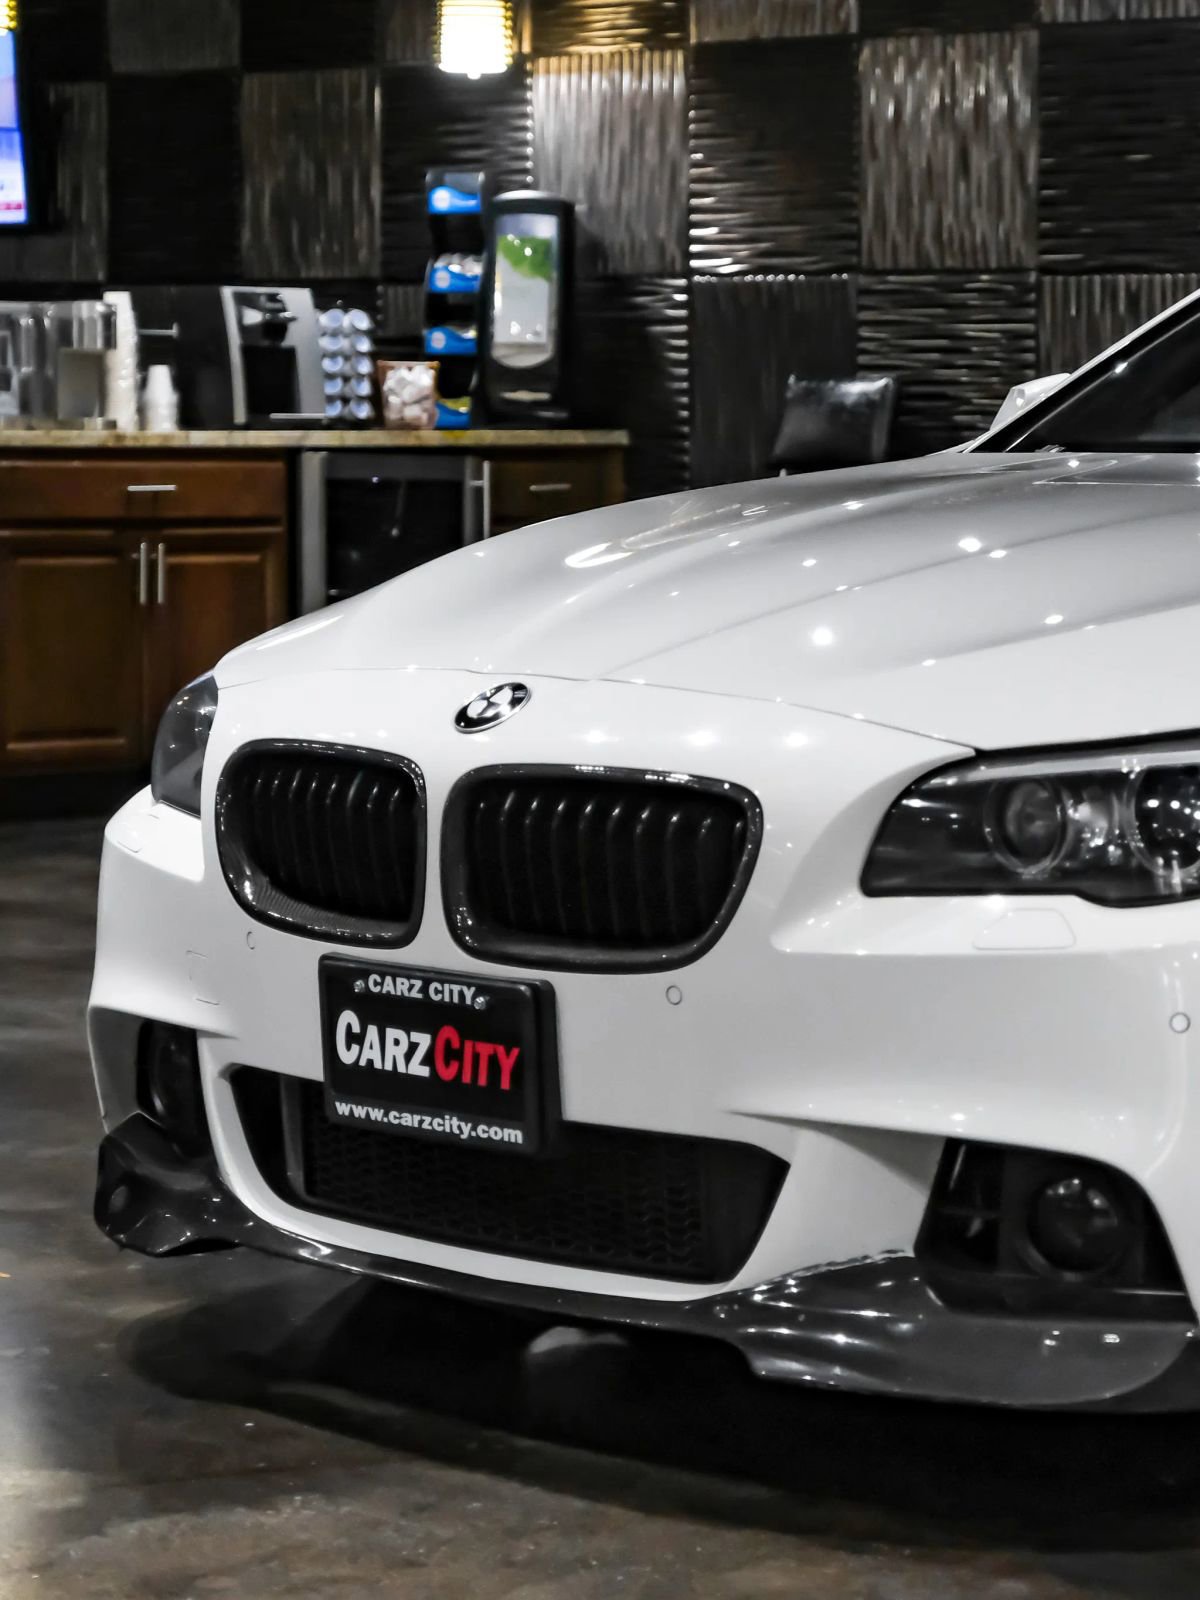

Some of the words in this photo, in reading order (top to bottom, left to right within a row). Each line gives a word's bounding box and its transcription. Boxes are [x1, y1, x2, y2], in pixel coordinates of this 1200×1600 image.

[368, 974, 423, 999] CARZ
[428, 982, 476, 1005] CITY
[335, 1101, 523, 1144] www.carzcity.com
